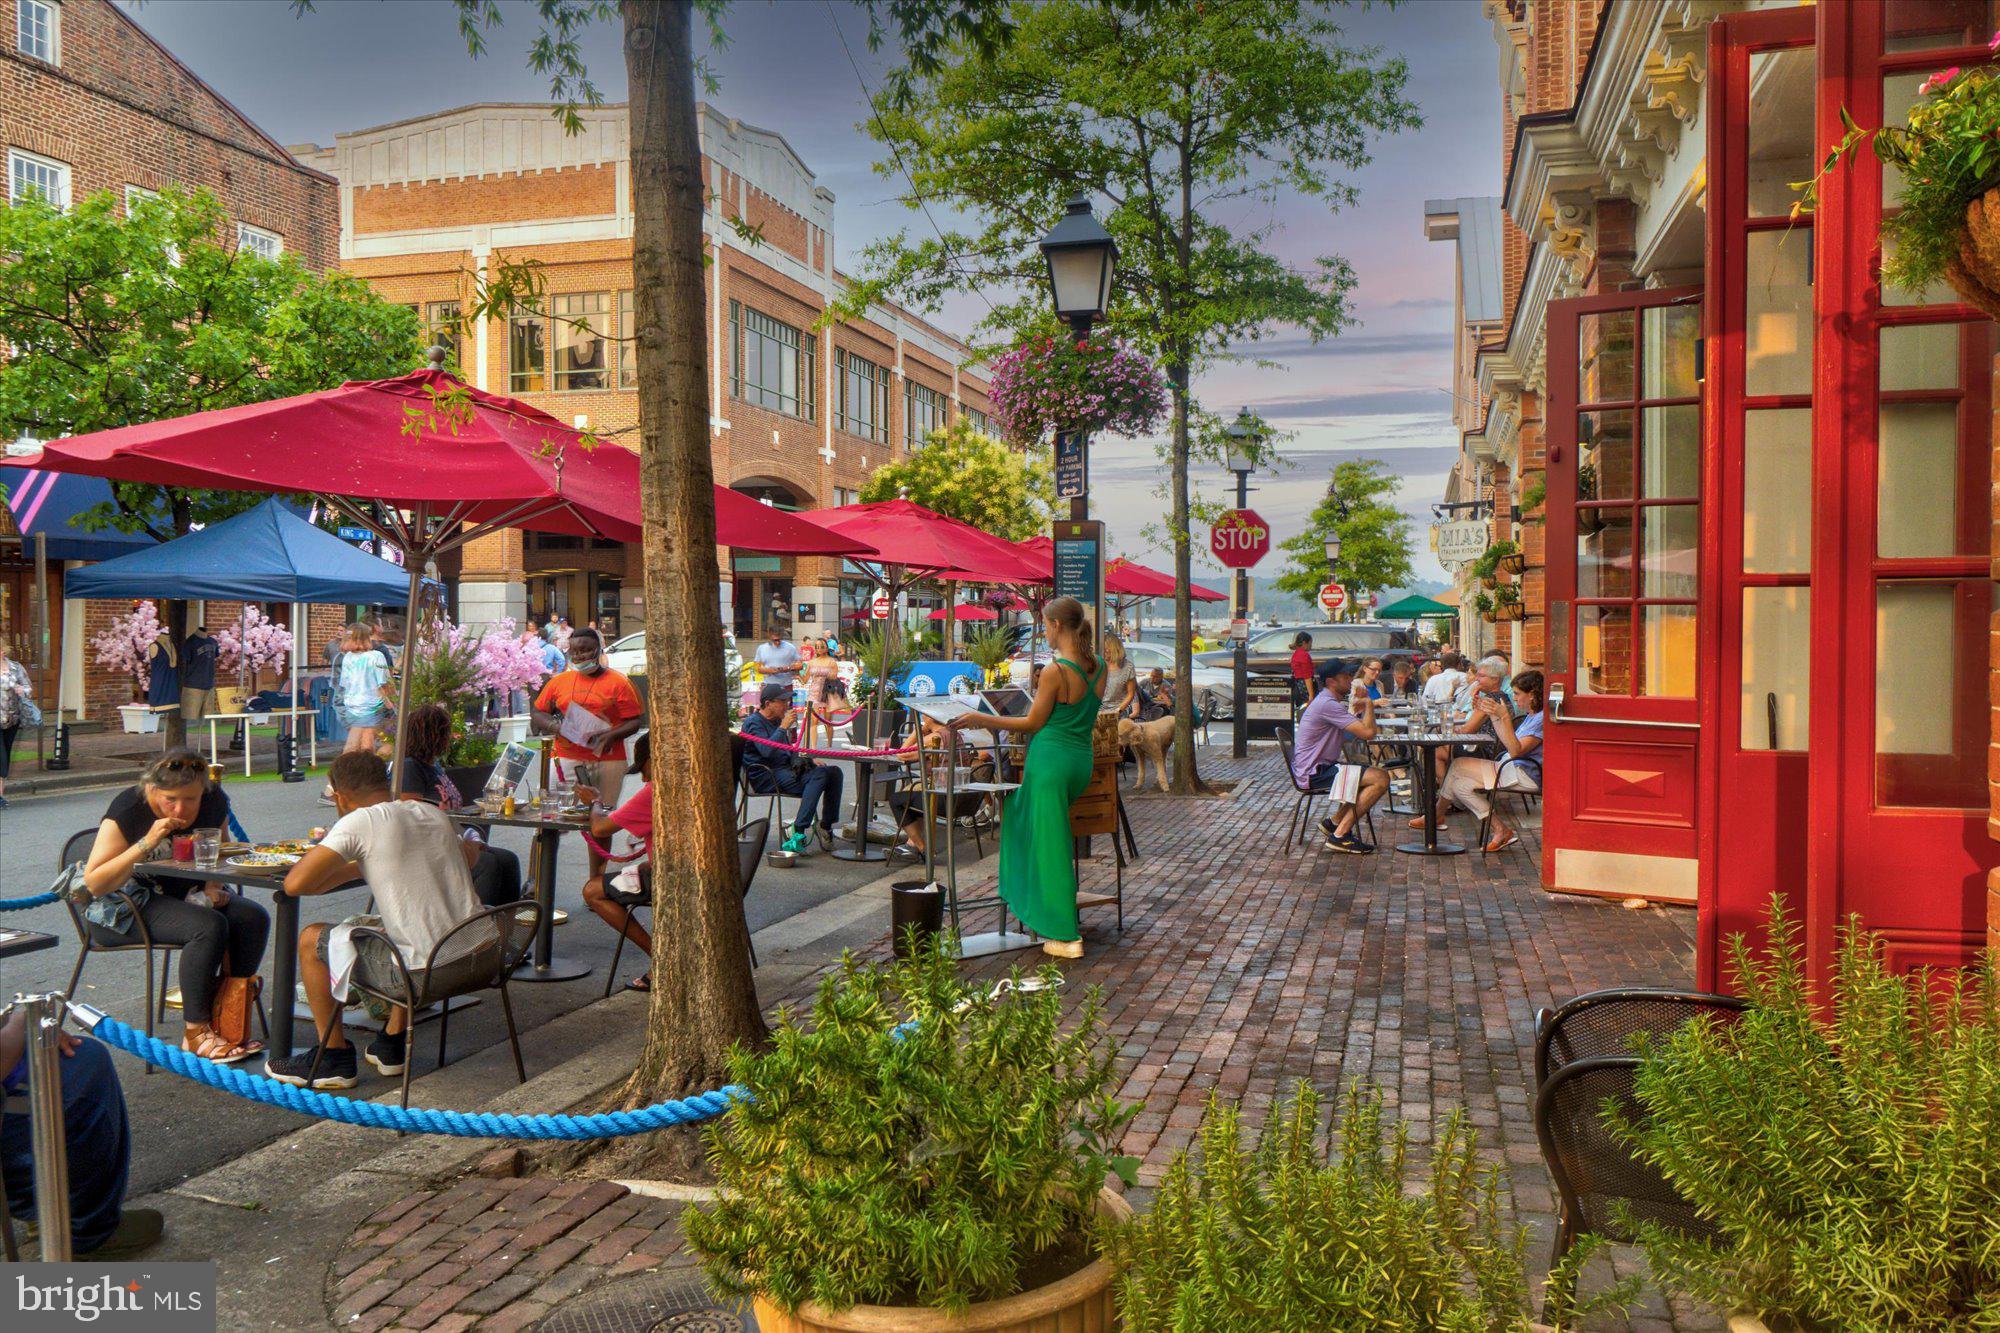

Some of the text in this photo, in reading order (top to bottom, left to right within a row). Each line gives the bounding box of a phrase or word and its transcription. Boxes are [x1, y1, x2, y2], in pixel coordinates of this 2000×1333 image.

[340, 528, 354, 538] KING
[1215, 527, 1266, 550] STOP
[1441, 527, 1484, 546] MIA'S
